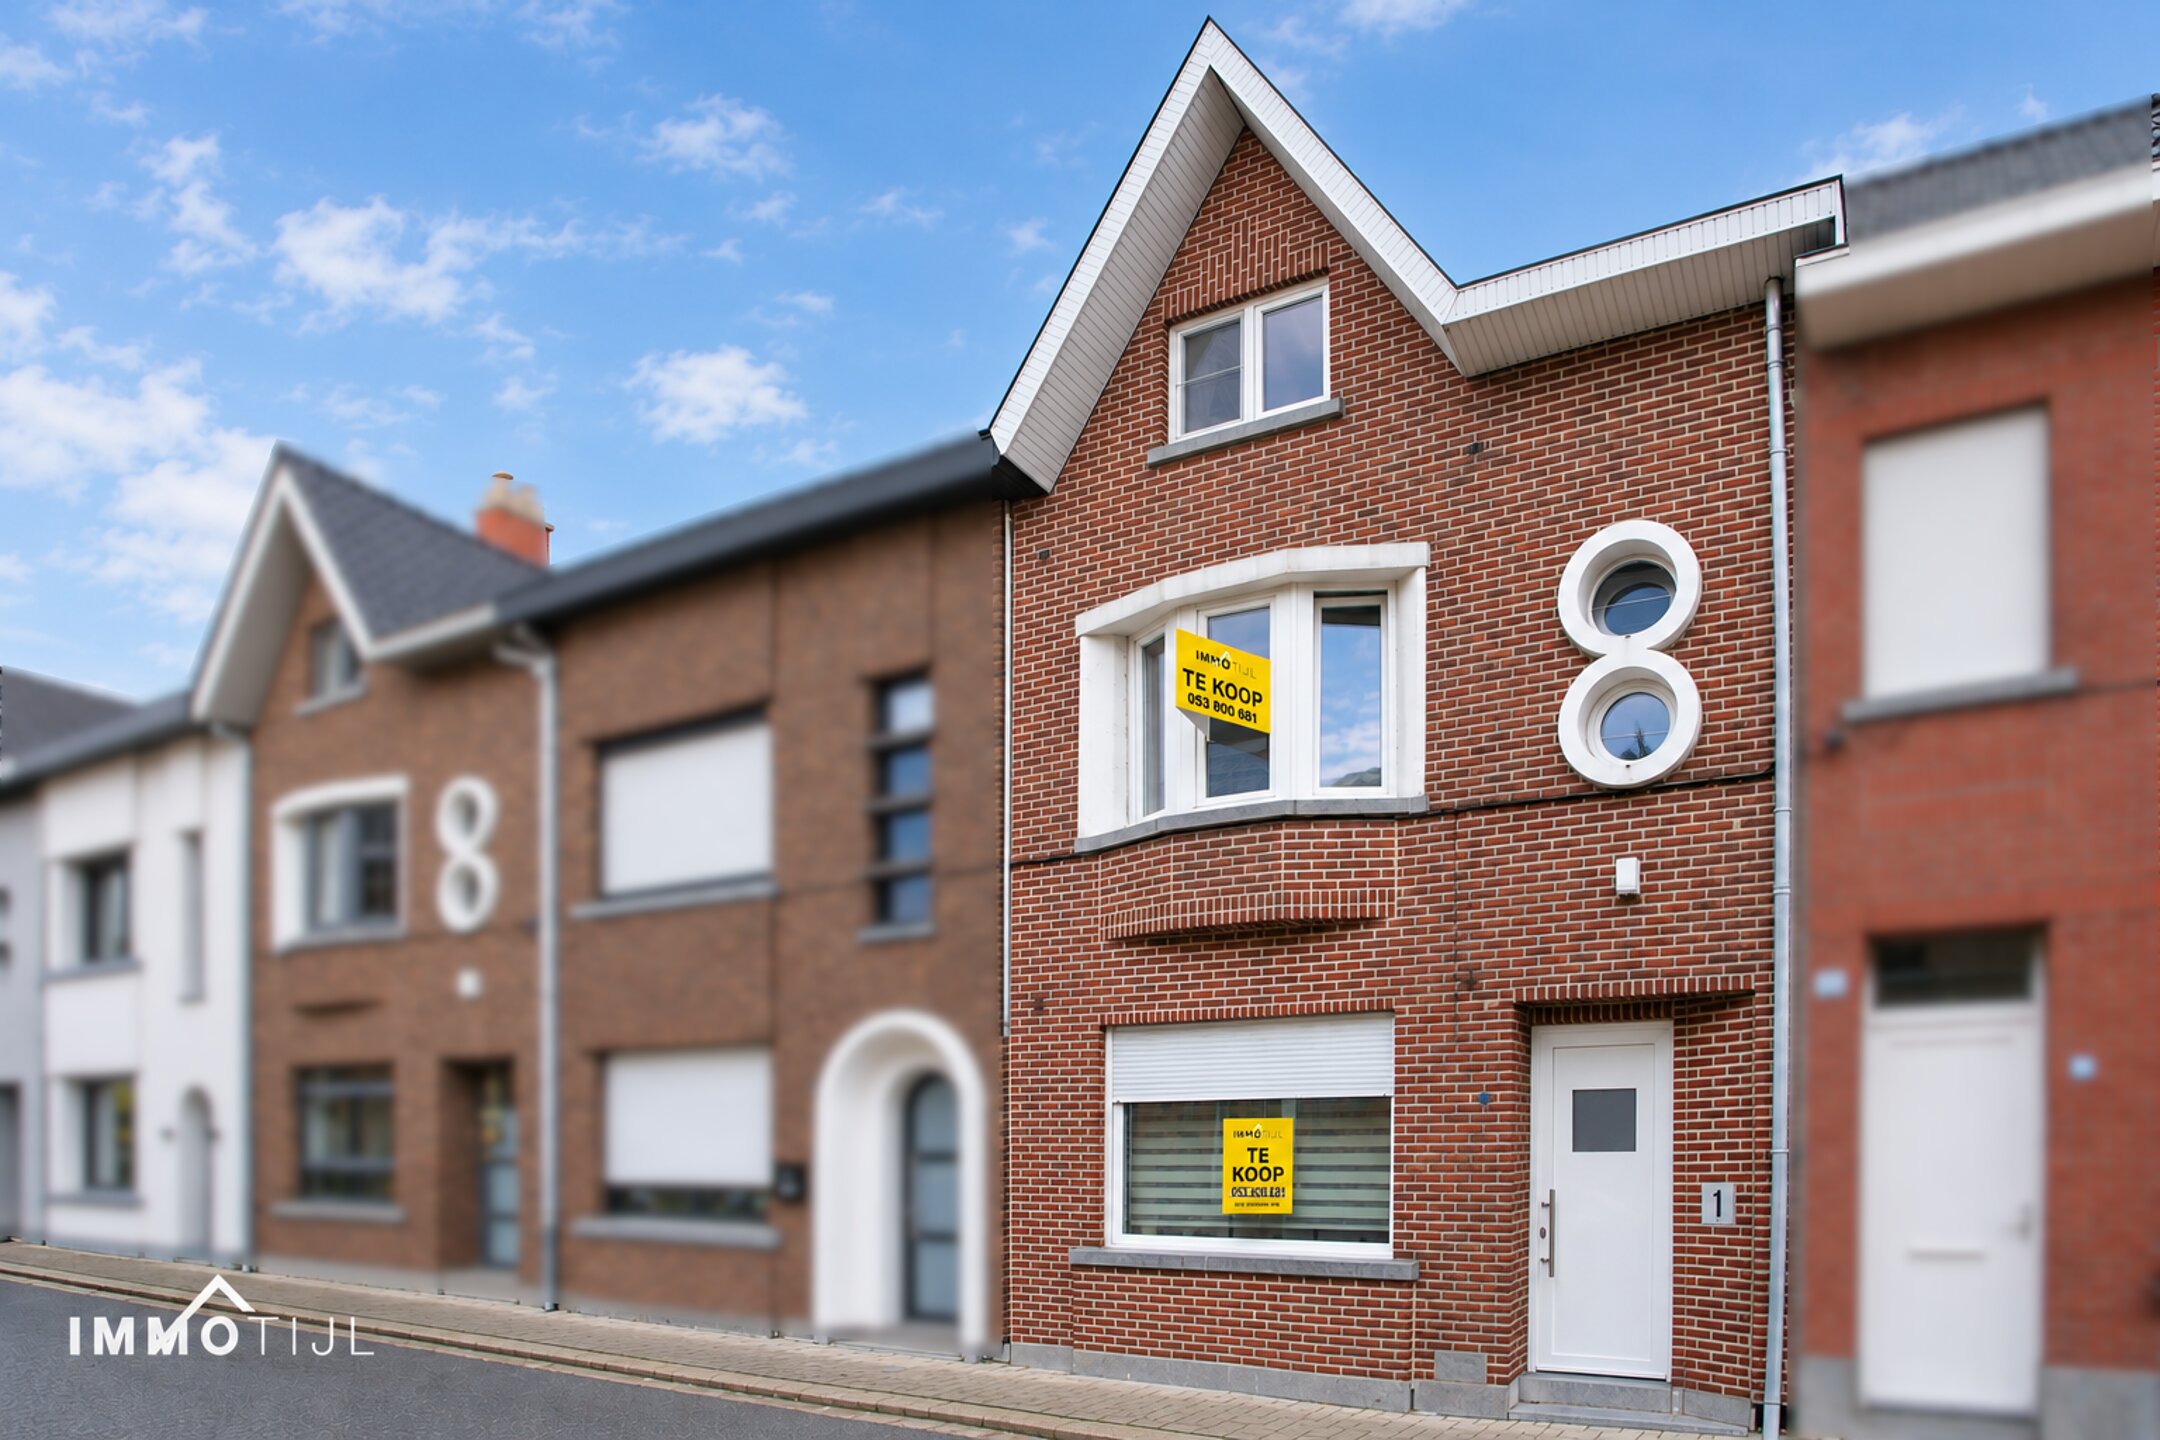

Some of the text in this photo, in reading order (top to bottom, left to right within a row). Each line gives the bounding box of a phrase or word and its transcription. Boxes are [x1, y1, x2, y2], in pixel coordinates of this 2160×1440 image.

[1182, 667, 1263, 707] TE KOOP
[1188, 692, 1257, 723] 053 800 681
[1247, 1147, 1269, 1163] TE
[1232, 1166, 1284, 1182] KOOP
[1713, 1189, 1721, 1217] 1
